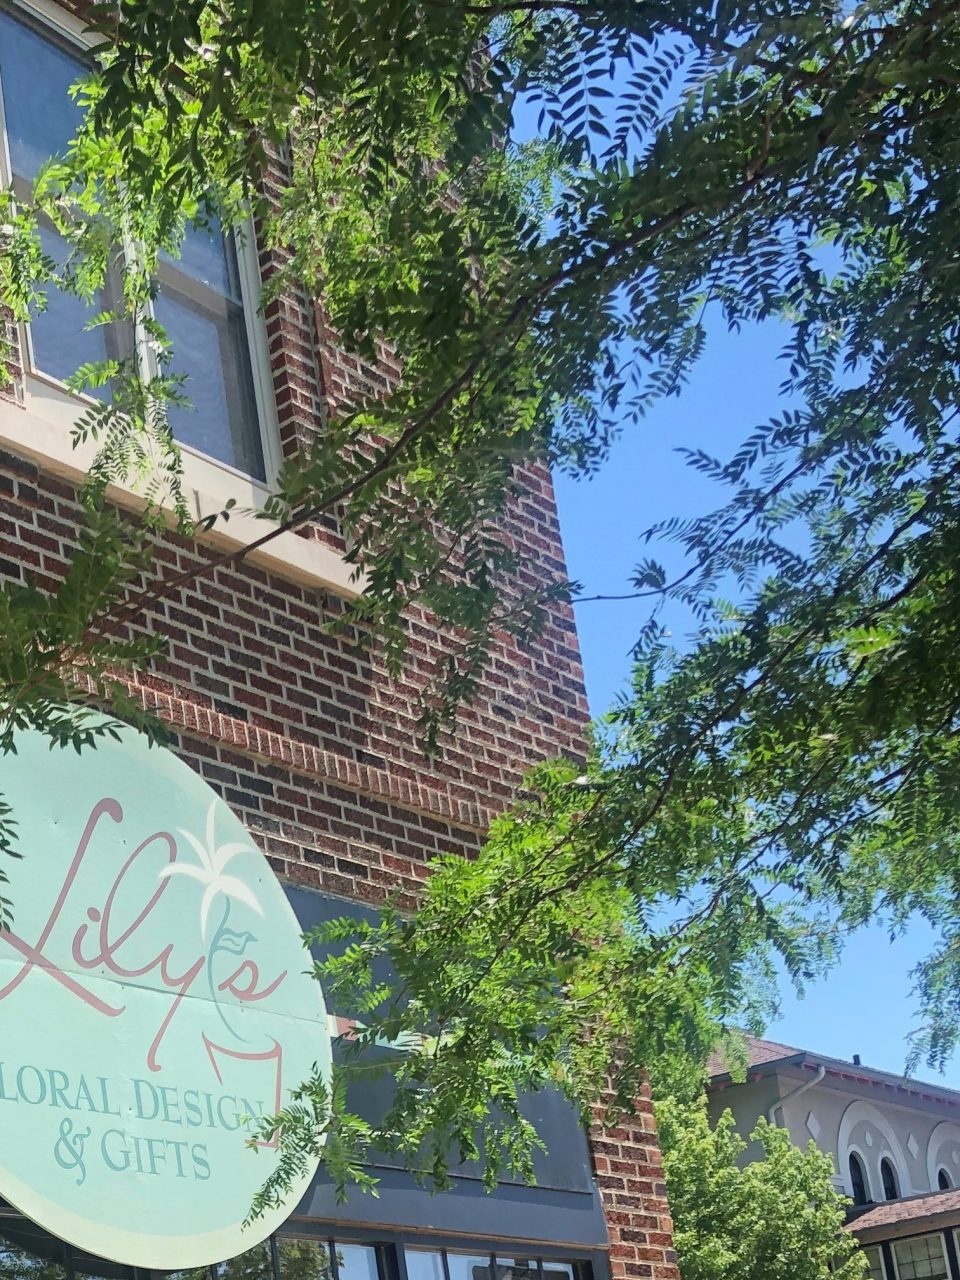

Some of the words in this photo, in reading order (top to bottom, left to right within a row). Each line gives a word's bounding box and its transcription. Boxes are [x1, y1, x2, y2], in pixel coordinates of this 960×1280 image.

[129, 1078, 265, 1133] DESIGN
[53, 1117, 92, 1186] &
[100, 1128, 212, 1181] GIFTS
